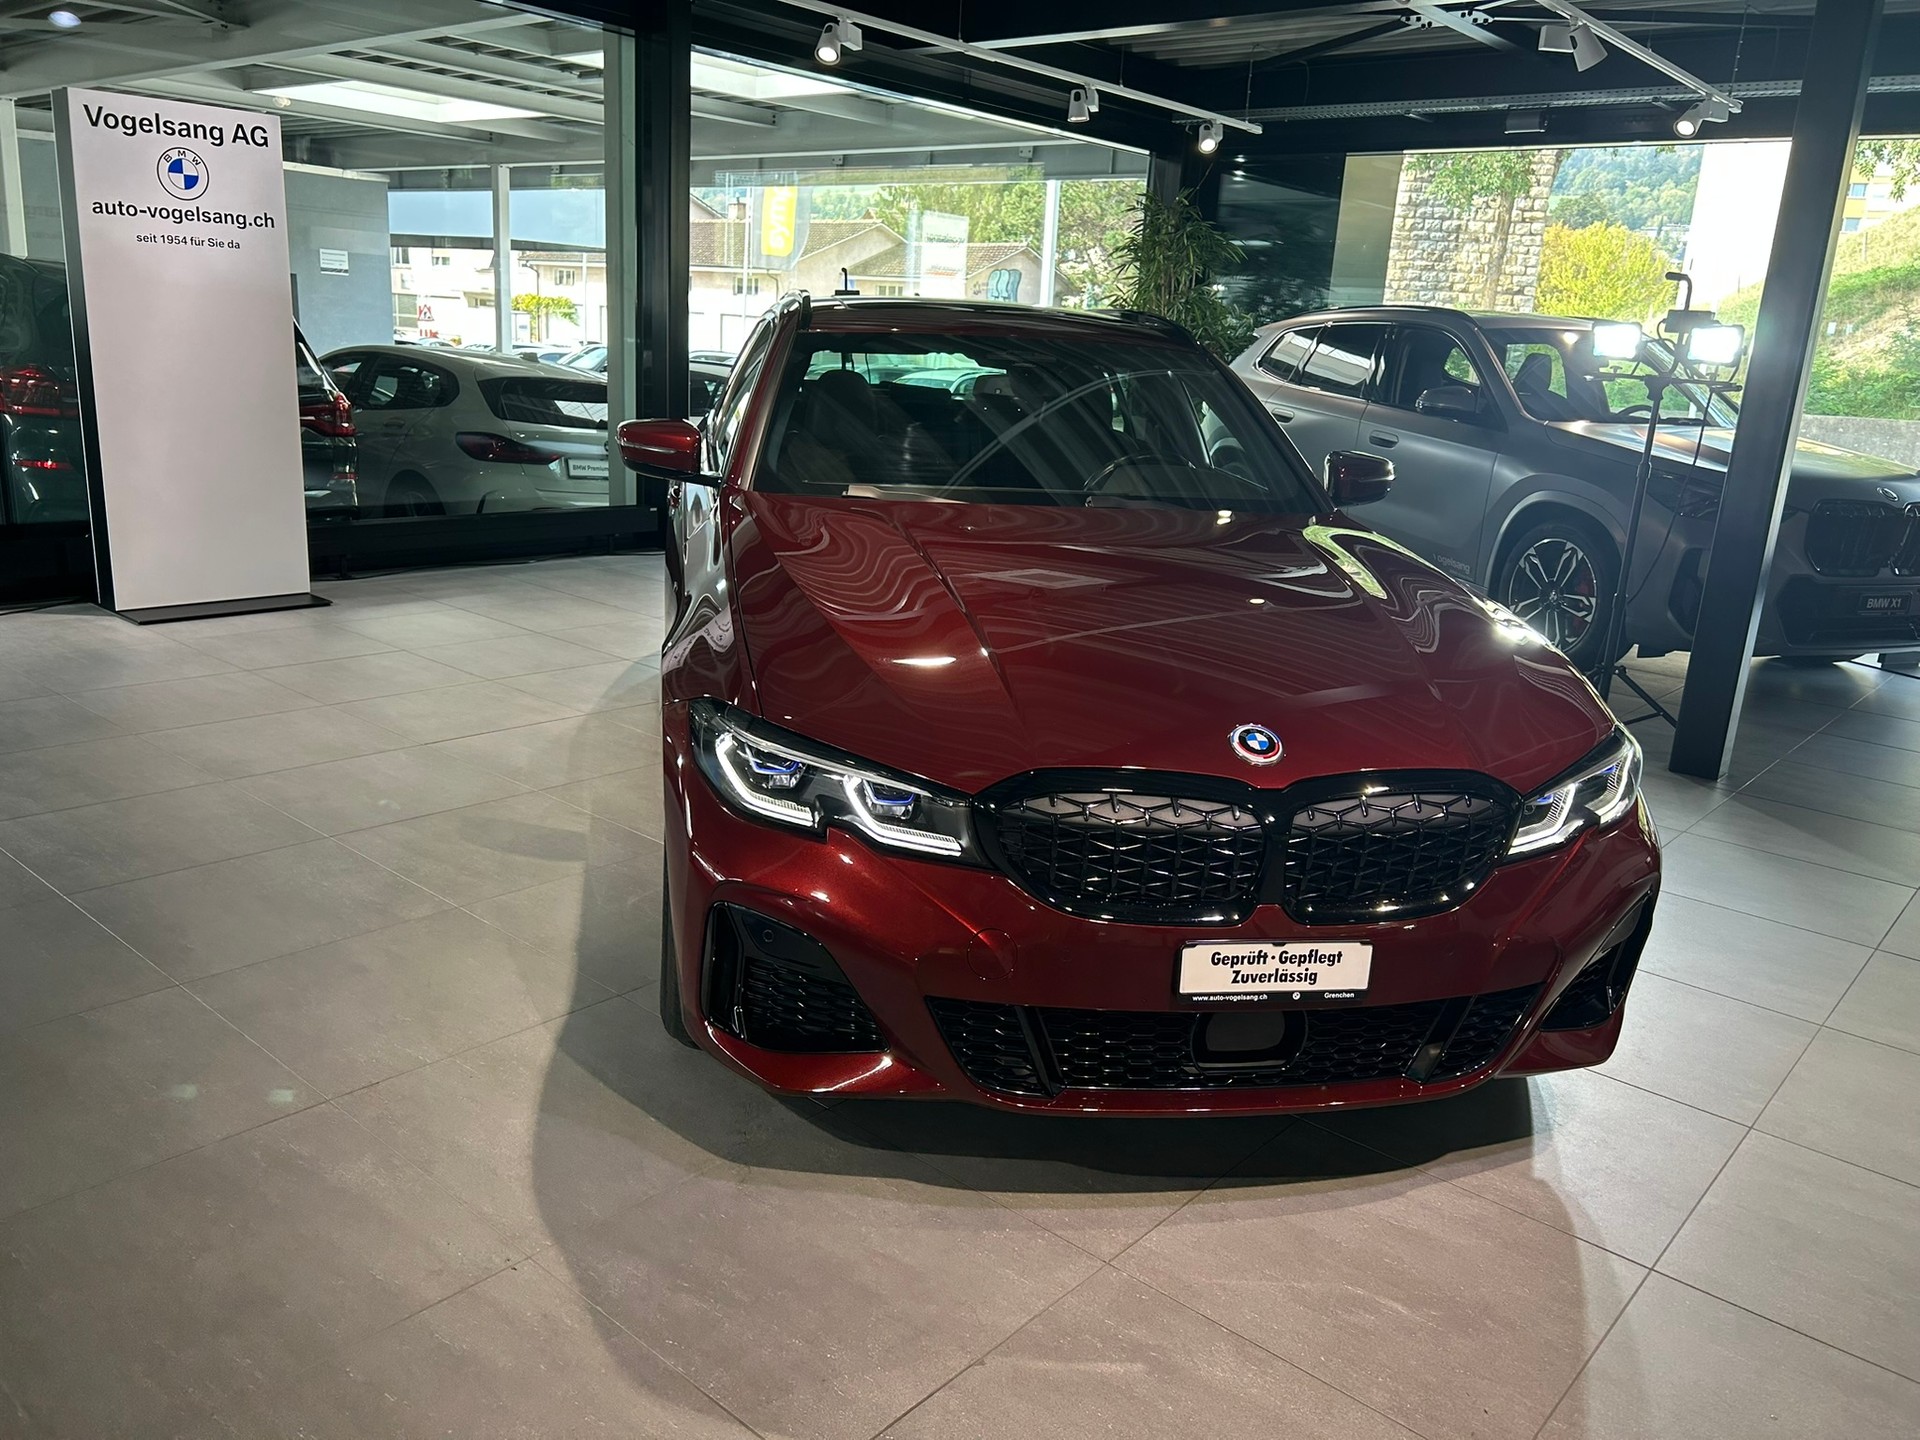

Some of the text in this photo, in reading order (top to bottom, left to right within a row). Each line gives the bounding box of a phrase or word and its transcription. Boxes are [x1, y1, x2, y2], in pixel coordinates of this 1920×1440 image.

[83, 104, 269, 148] Vogelsang AG
[163, 149, 202, 166] BMW
[92, 200, 275, 230] auto-vogelsang.ch
[136, 233, 241, 250] seit 1954 für Sie da
[1866, 598, 1902, 609] BMW X1
[1210, 949, 1343, 968] Geprüft Gepflegt
[1231, 968, 1318, 985] Zuverlässig
[1192, 991, 1355, 1002] www.auto-vogelsang.ch Grenchen
